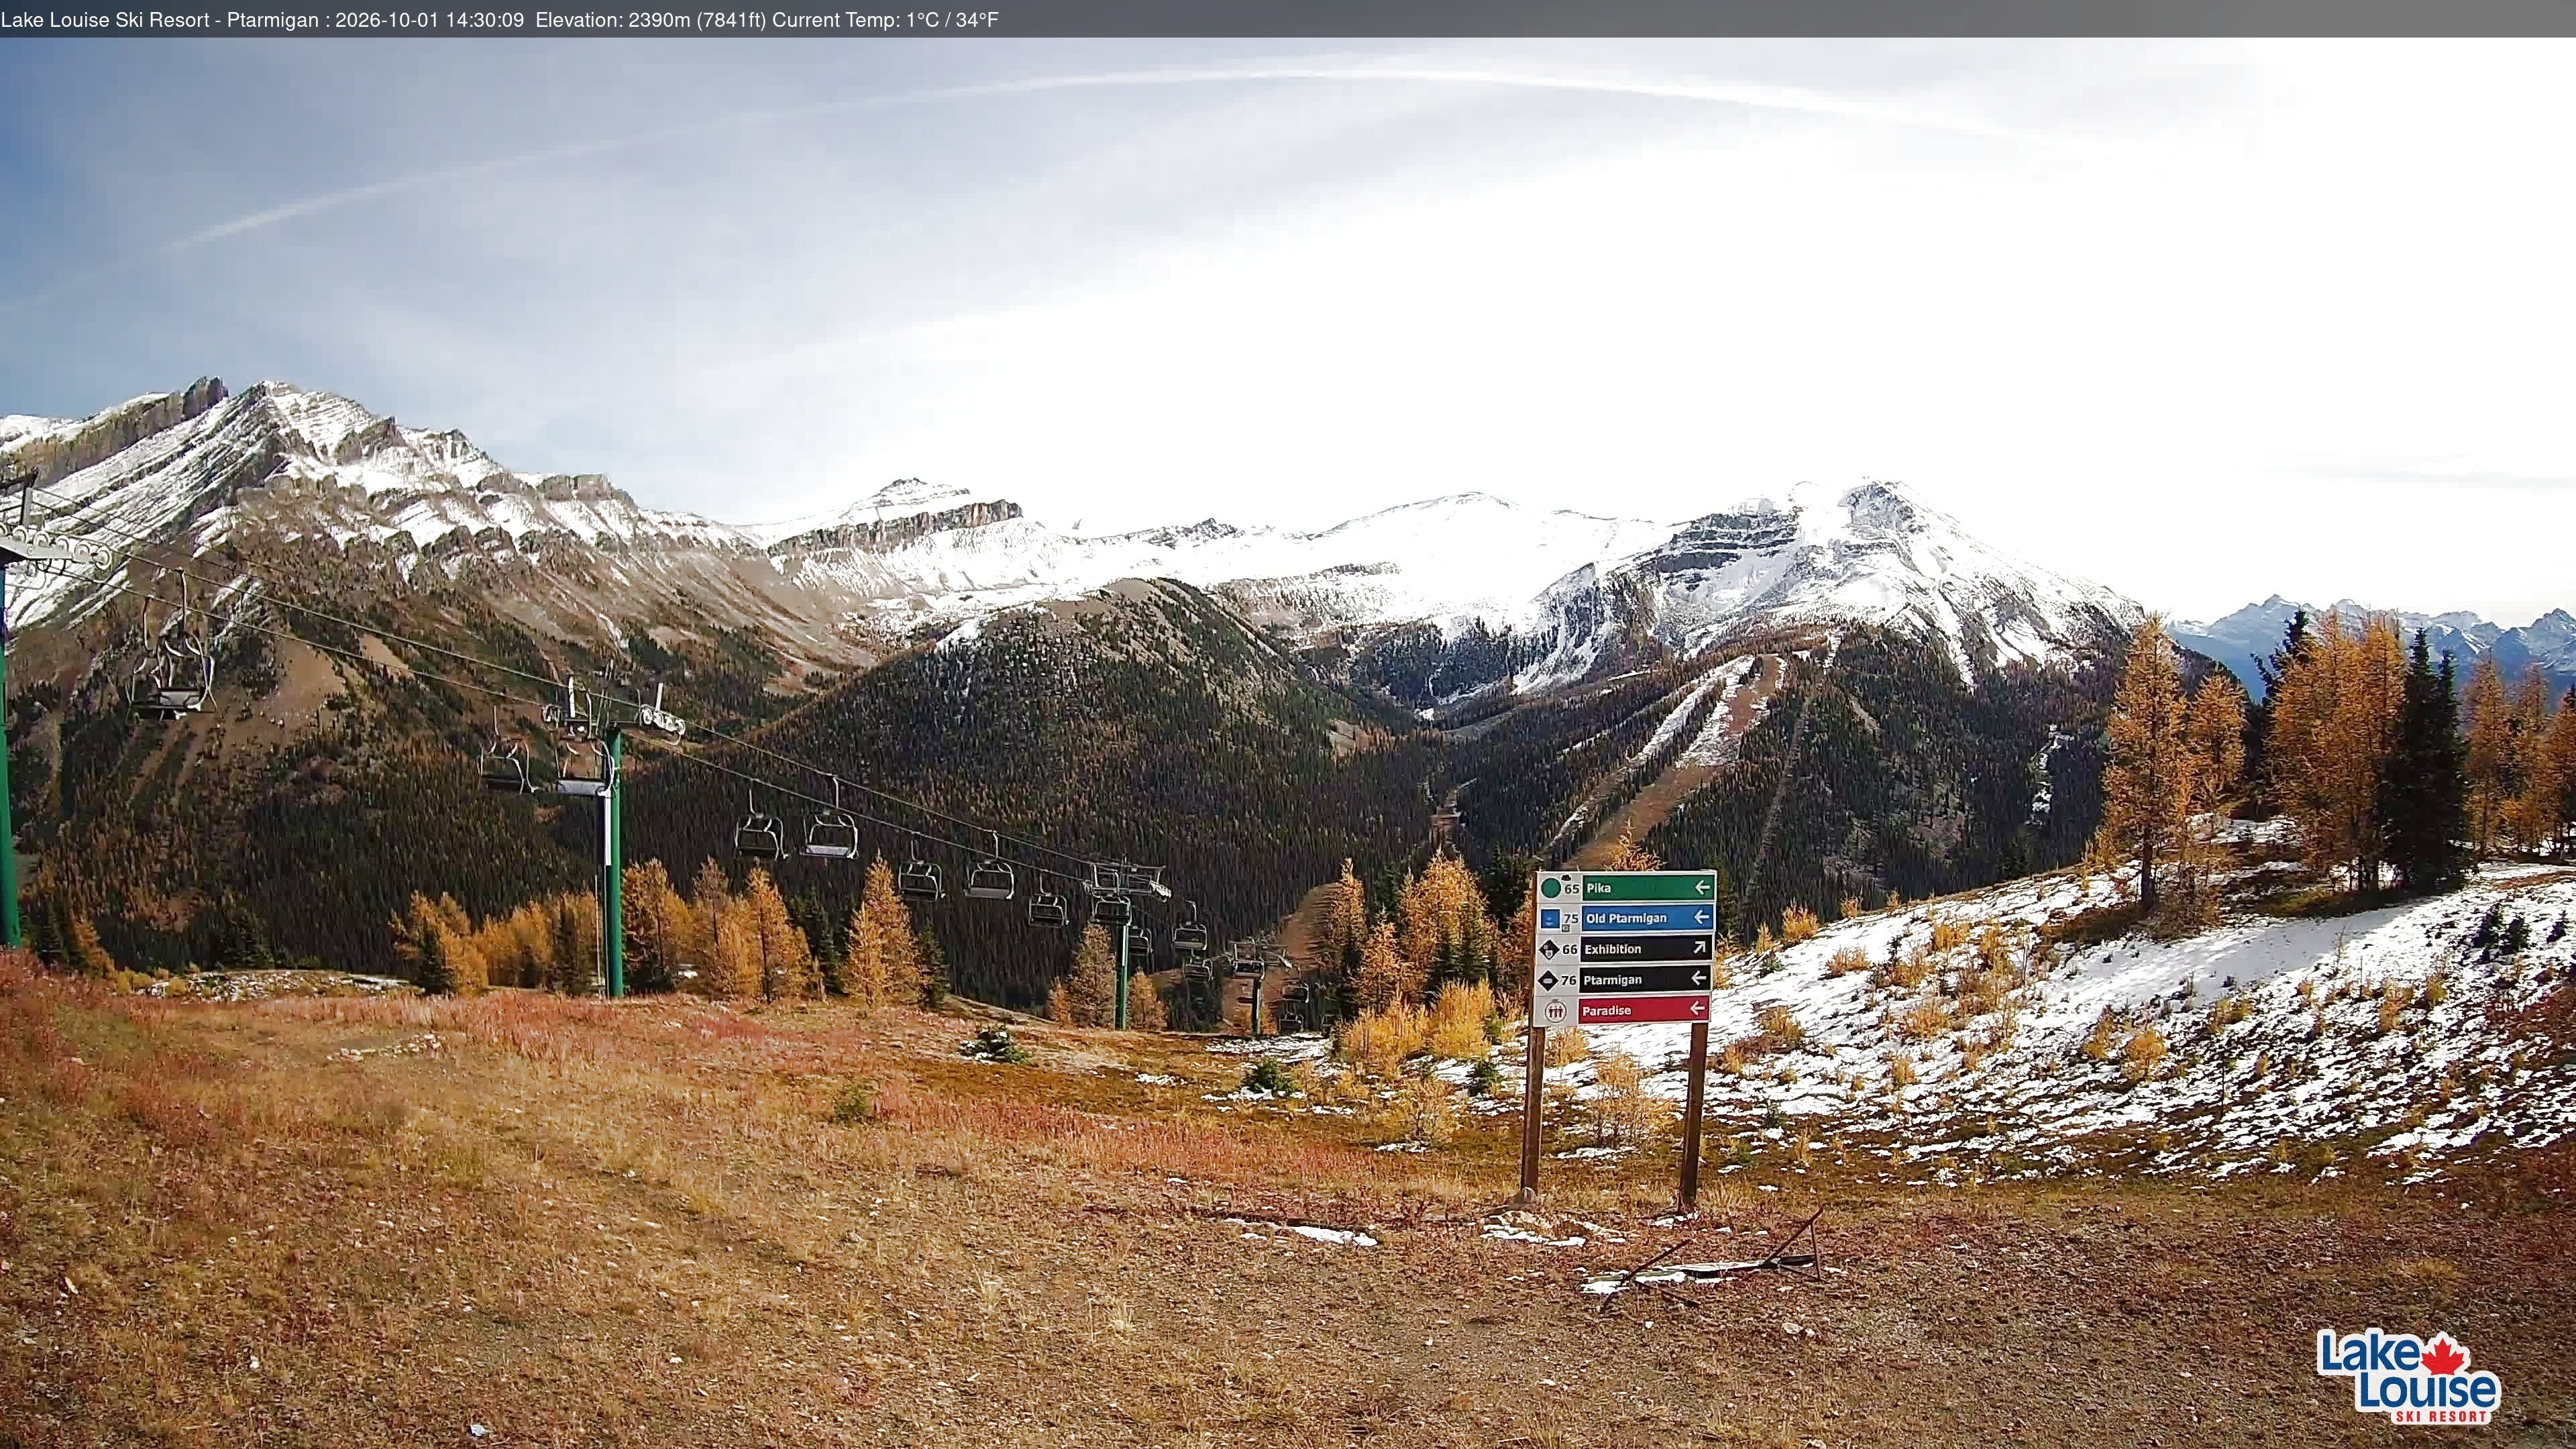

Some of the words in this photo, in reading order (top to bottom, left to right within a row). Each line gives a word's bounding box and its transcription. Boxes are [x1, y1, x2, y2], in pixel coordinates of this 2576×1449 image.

[1564, 884, 1580, 894] 65
[1587, 883, 1611, 893] Pika
[1564, 914, 1578, 924] 75
[1587, 913, 1605, 924] Old
[1609, 913, 1667, 925] Ptarmigan
[1562, 945, 1578, 955] 66
[1585, 944, 1642, 955] Exhibition
[1561, 975, 1576, 985] 76
[1584, 975, 1642, 986] Ptarmigan
[1582, 1005, 1631, 1016] Paradise
